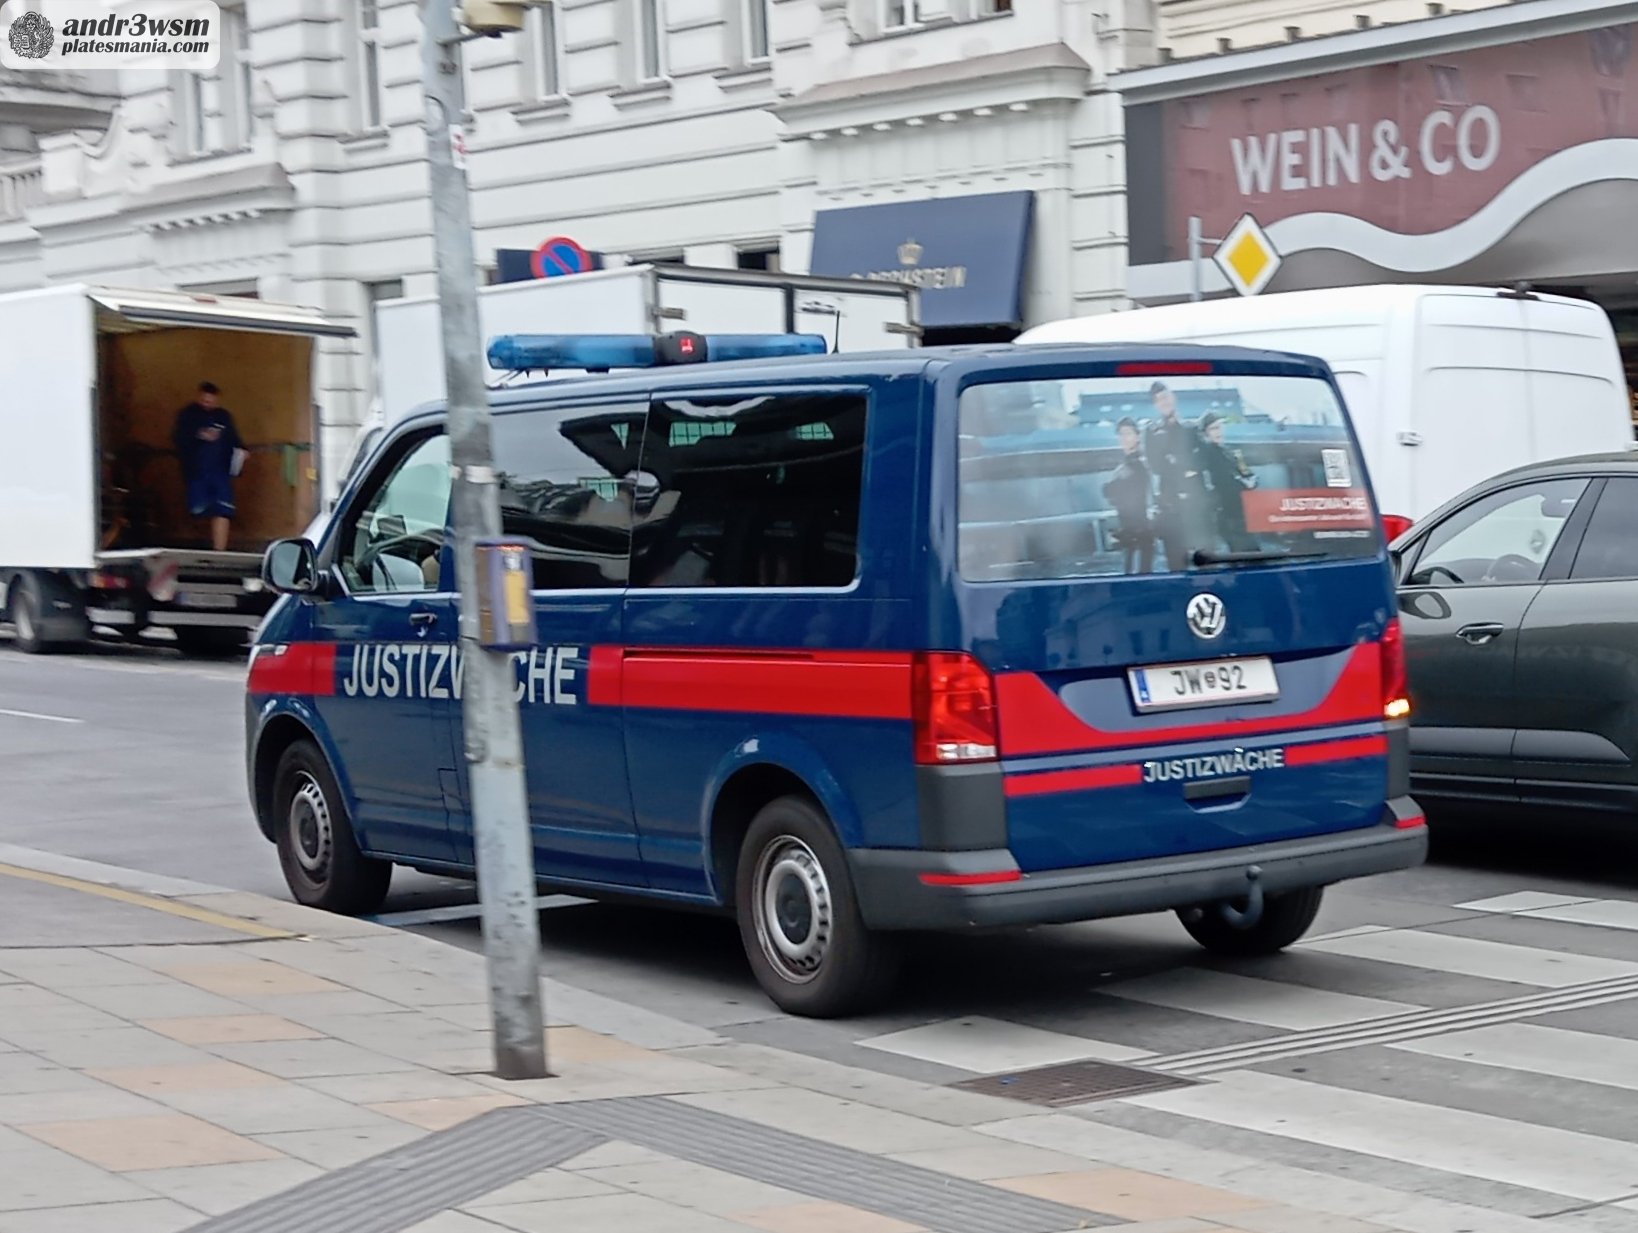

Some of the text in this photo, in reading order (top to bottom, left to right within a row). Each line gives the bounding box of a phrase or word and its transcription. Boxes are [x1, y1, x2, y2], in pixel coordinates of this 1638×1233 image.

[1230, 104, 1501, 195] WEIN & CO
[343, 644, 579, 706] JUSTIZCHE
[1171, 665, 1247, 696] JW 92
